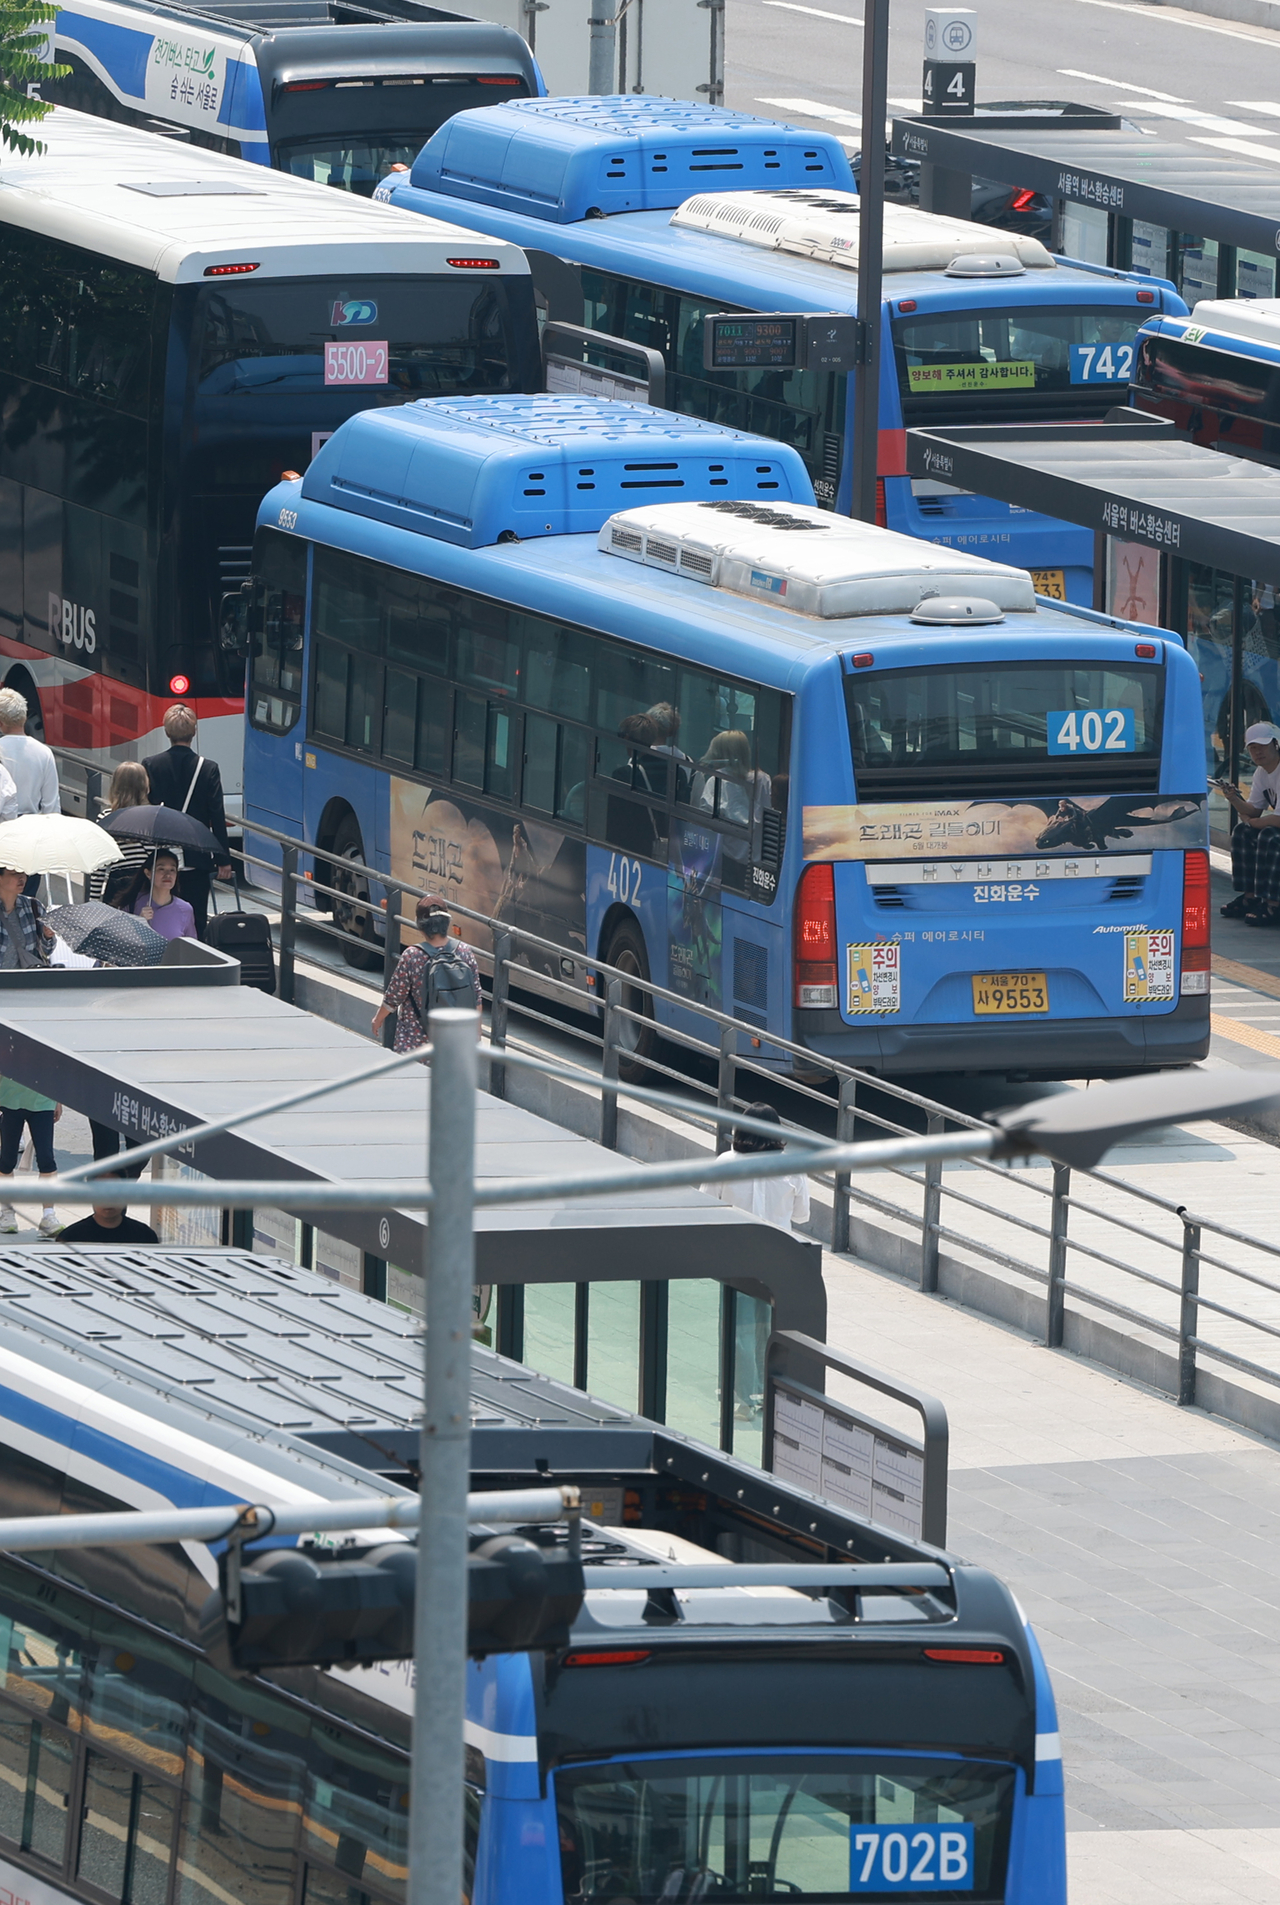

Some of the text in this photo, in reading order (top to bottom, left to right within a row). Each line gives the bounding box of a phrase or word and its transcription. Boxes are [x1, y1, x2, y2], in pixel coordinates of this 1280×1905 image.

[154, 38, 204, 74] 전기버스 타고
[26, 83, 42, 100] 5
[170, 73, 218, 110] 숨 쉬는 서울로
[924, 69, 933, 96] 4
[946, 71, 966, 97] 4
[1057, 171, 1124, 209] 서울역 버스환승센터
[718, 325, 743, 336] 7011
[756, 324, 782, 336] 9300
[327, 346, 386, 381] 5500-2
[1078, 344, 1133, 380] 742
[911, 366, 1033, 382] 양보해 주셔서 감사합니다.
[813, 479, 835, 498] 선진운수
[278, 508, 298, 530] 9553
[1102, 502, 1181, 548] 서울역 버스환승센터
[957, 533, 1010, 545] 에어로시티
[1034, 573, 1049, 582] 74
[1057, 710, 1126, 751] 402
[860, 820, 1001, 842] 드래곤 길들이기
[412, 829, 464, 885] 드래곤
[607, 852, 643, 908] 402
[753, 866, 776, 892] 진화운수
[922, 859, 1100, 881] HYUNDAI
[973, 884, 1040, 903] 진화운수
[891, 931, 915, 943] 슈퍼
[921, 930, 985, 943] 에어로시티
[1092, 923, 1149, 934] Automatic
[1148, 935, 1171, 958] 주의
[873, 947, 898, 969] 주의
[990, 975, 1028, 987] 서울 70
[111, 1090, 139, 1131] 서울역
[855, 1831, 968, 1882] 702B
